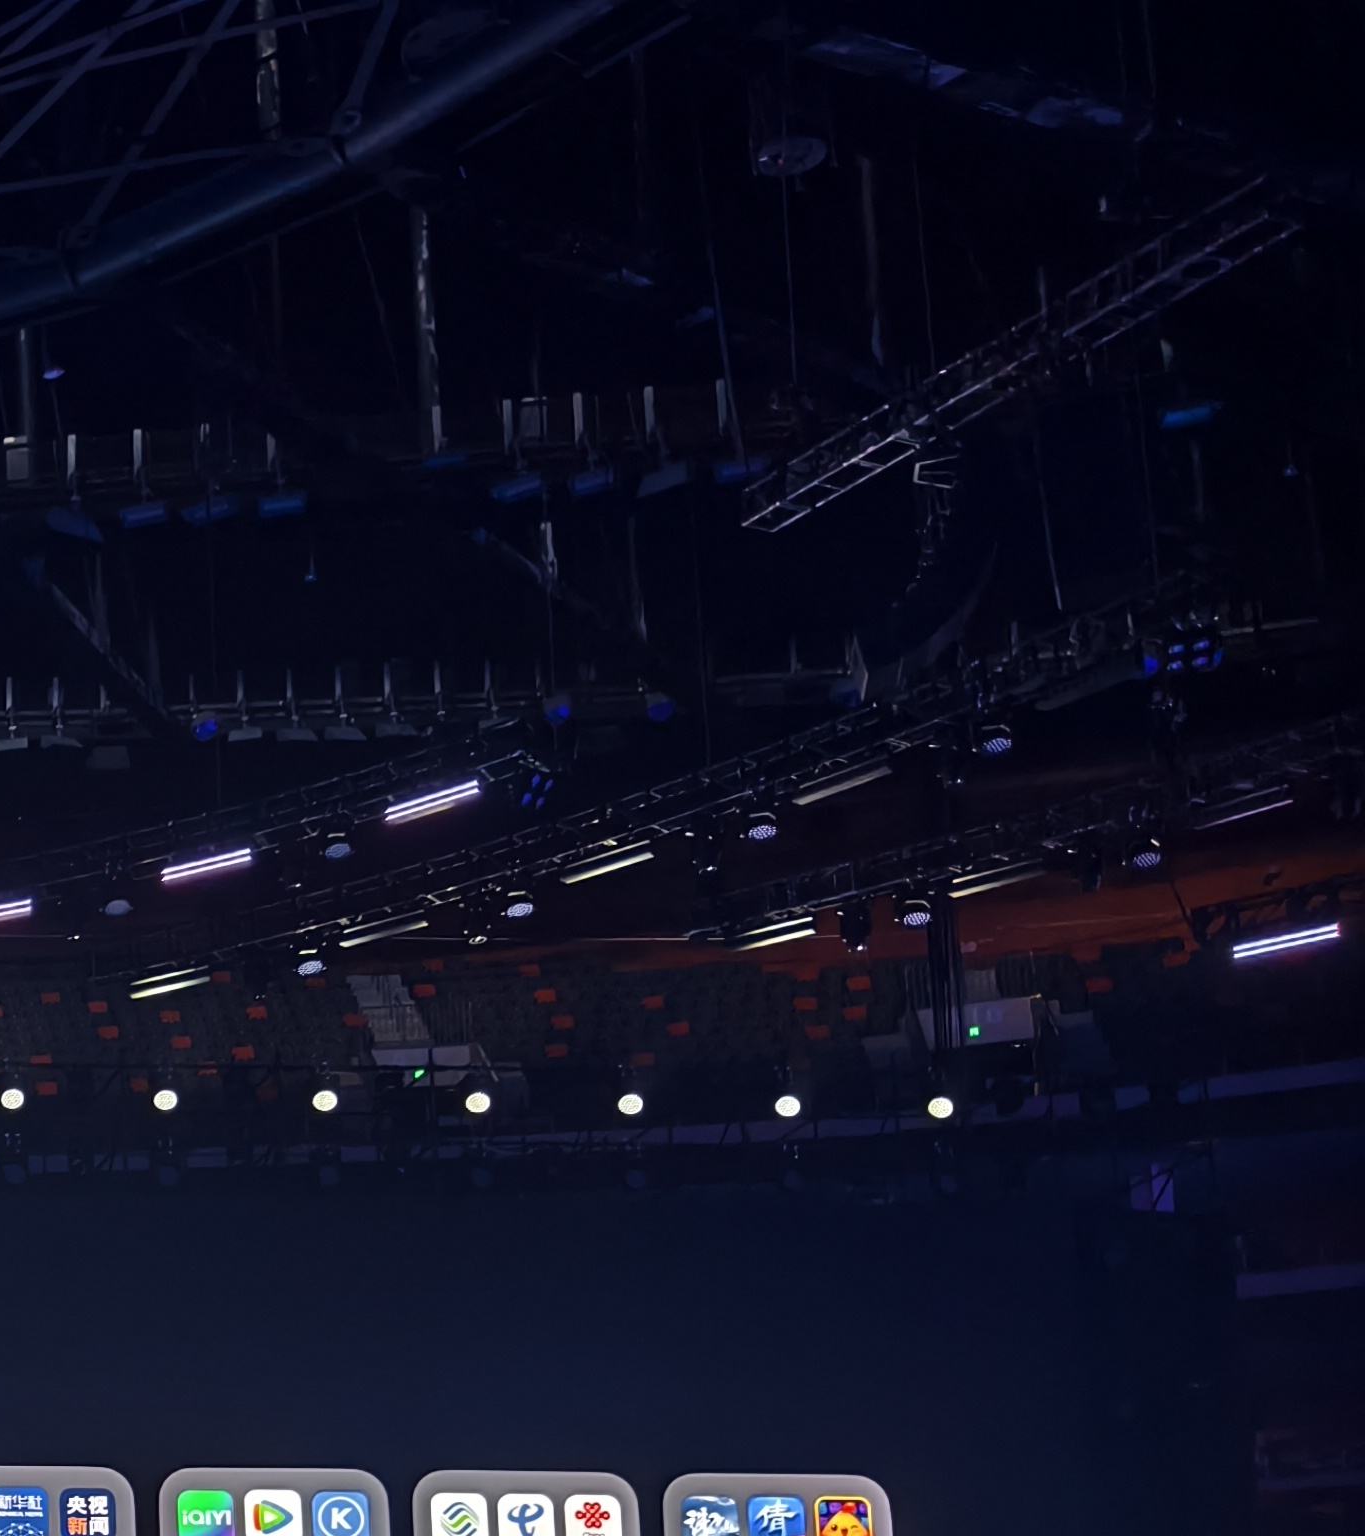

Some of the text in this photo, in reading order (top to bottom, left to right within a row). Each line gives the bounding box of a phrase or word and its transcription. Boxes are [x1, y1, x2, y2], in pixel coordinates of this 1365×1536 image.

[67, 1496, 109, 1516] 央视
[67, 1517, 109, 1536] 新闻
[181, 1510, 231, 1526] iQIYI
